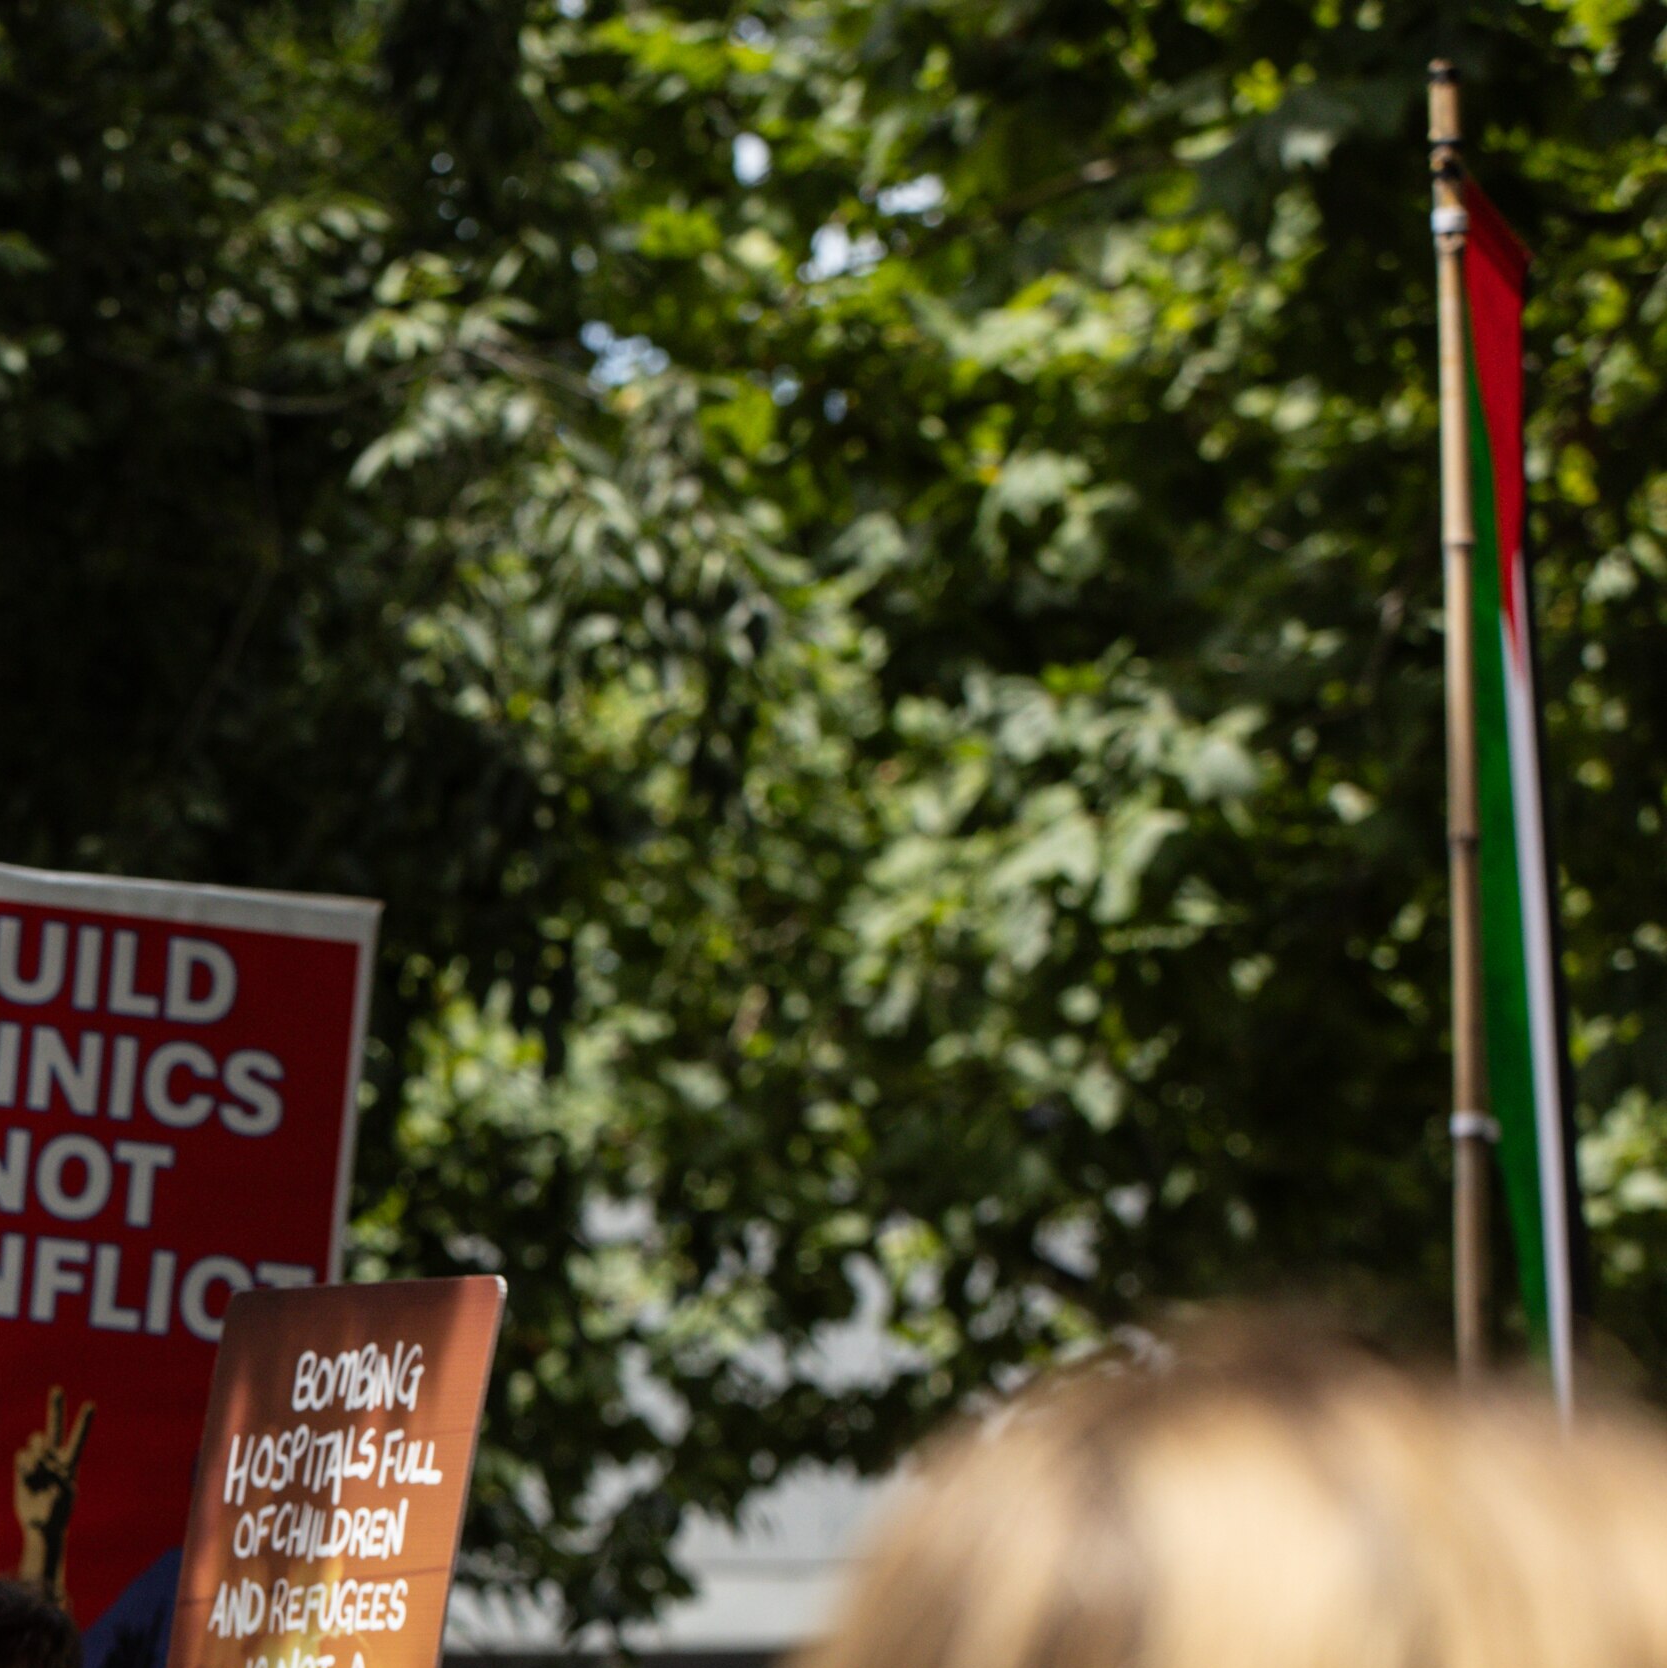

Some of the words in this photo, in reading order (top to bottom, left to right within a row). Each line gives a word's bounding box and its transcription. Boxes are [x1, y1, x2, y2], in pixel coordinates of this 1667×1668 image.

[292, 1341, 425, 1412] BOMBING
[223, 1424, 376, 1505] HOSPITALS
[378, 1428, 442, 1488] FULL
[233, 1504, 277, 1559] OF
[271, 1498, 409, 1564] CHILDREN
[208, 1578, 265, 1639] AND
[270, 1578, 408, 1635] REFUGEES
